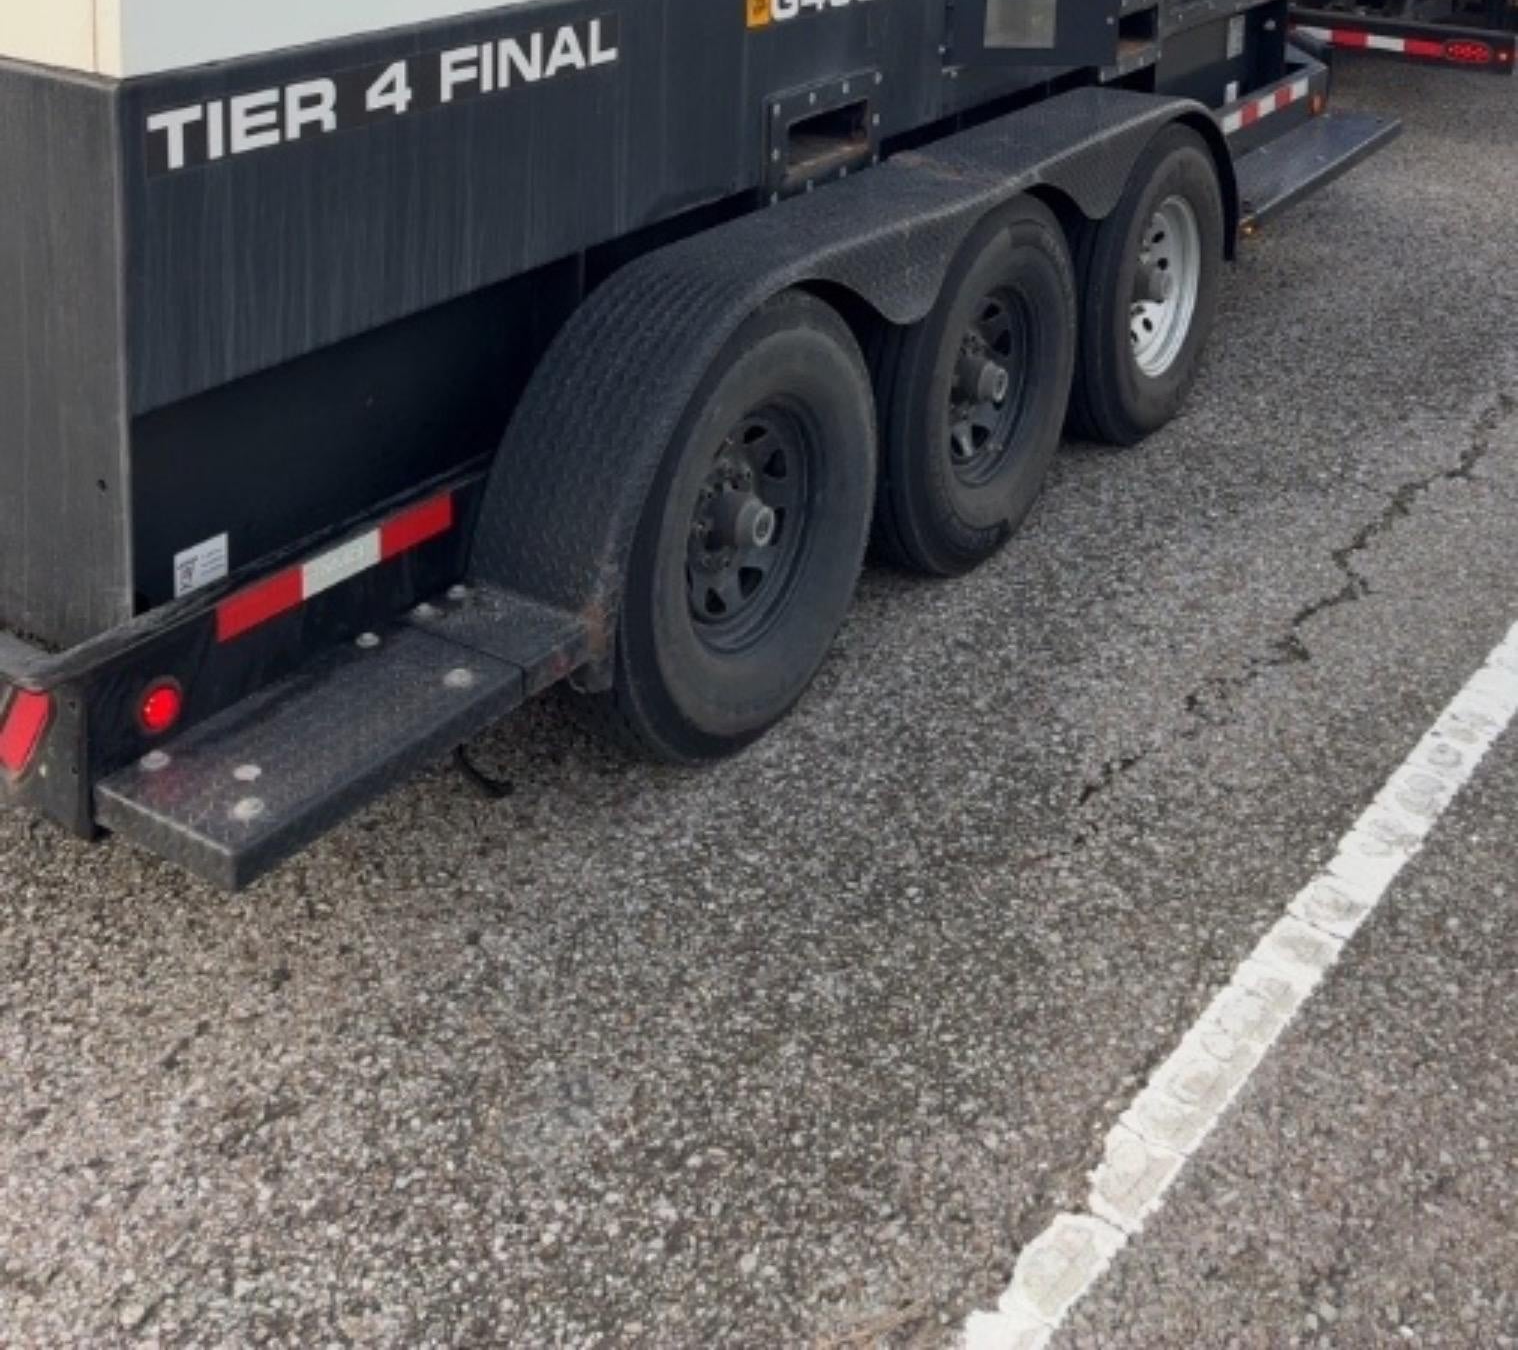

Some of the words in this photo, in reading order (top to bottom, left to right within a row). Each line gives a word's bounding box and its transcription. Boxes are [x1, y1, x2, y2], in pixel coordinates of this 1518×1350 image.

[147, 78, 337, 171] TIER
[366, 60, 412, 115] 4
[440, 18, 619, 103] FINAL
